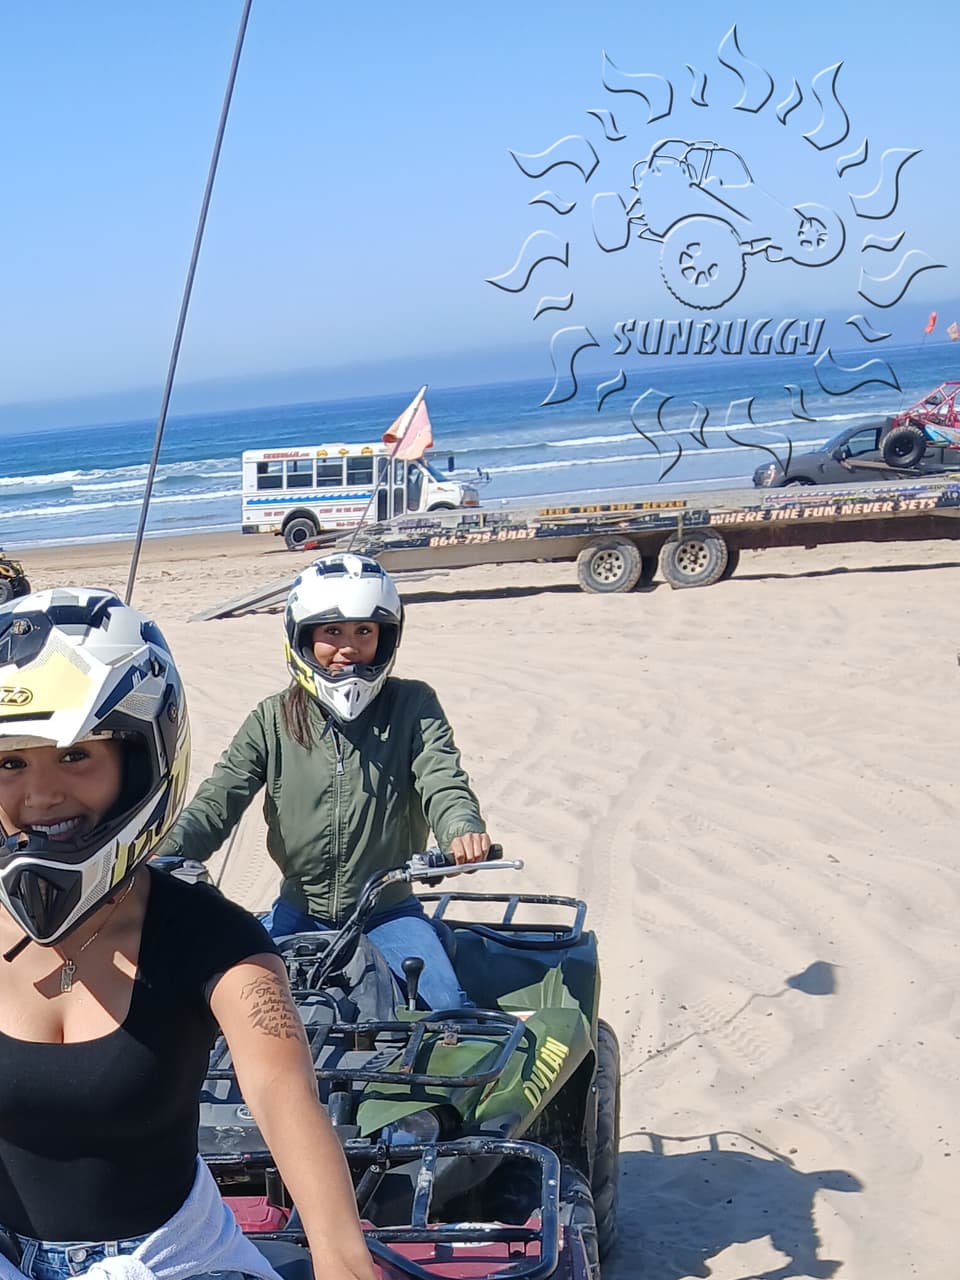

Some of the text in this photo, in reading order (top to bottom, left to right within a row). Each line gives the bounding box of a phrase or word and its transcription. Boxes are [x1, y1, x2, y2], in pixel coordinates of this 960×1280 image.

[710, 497, 938, 525] WHERE THE FUN NEVER SETS
[523, 1036, 570, 1111] DYLAN
